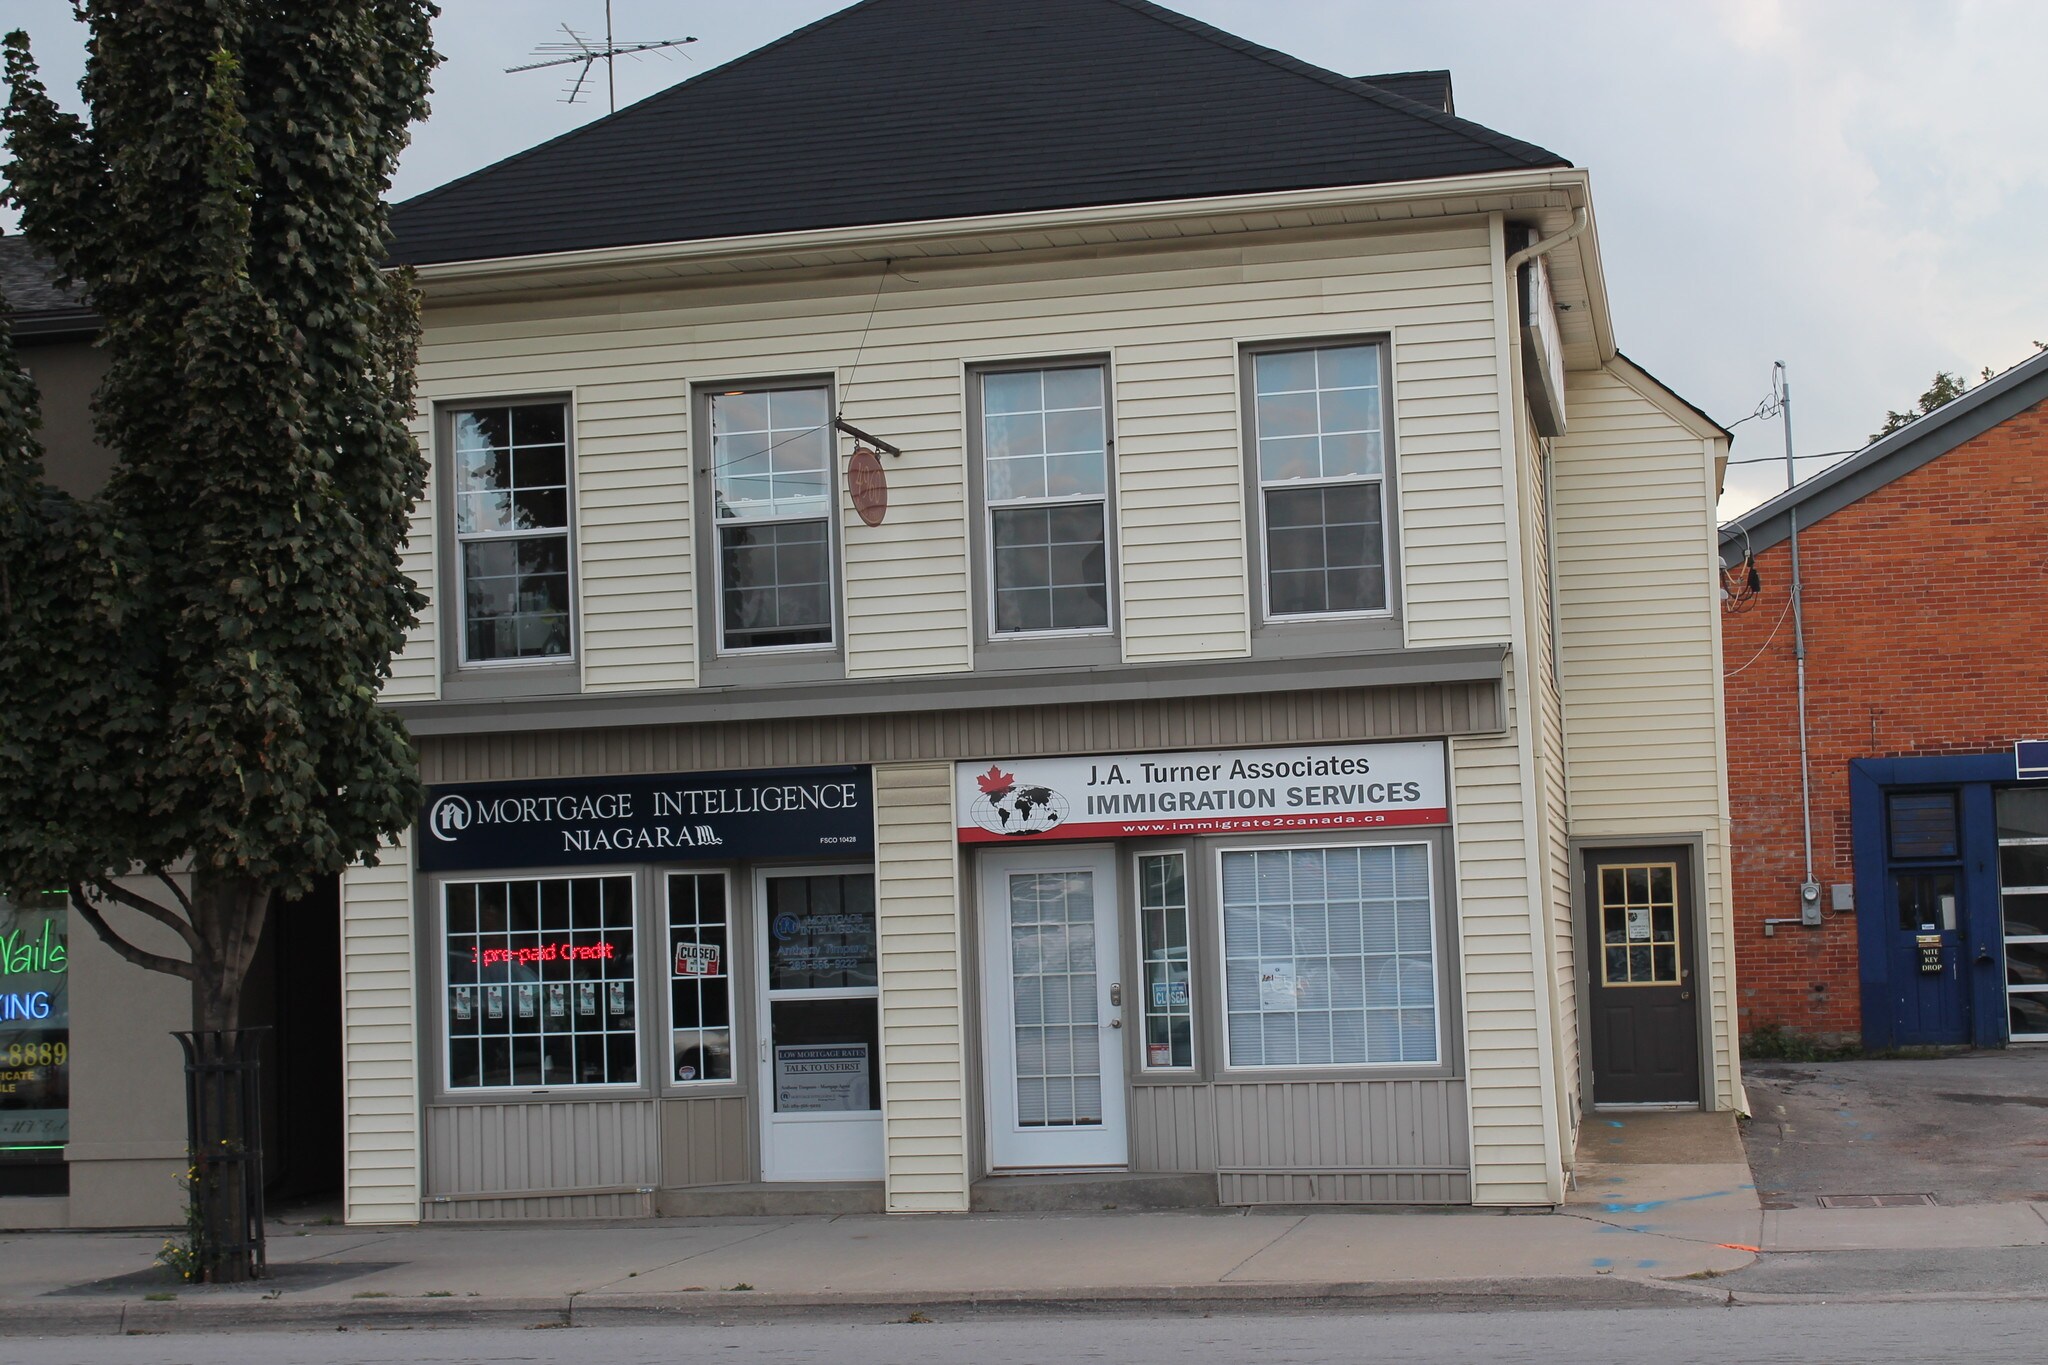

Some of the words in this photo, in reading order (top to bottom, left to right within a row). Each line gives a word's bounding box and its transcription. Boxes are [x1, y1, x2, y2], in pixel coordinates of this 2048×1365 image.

[1087, 764, 1131, 786] J.A.
[1140, 762, 1221, 784] Turner
[1229, 756, 1370, 780] Associates
[476, 794, 634, 824] MORTGAGE
[653, 783, 858, 816] INTELLIGENCE
[1087, 788, 1276, 815] IMMIGRATION
[1286, 781, 1421, 807] SERVICES
[1122, 815, 1385, 832] www.immigrate2canada.ca
[561, 825, 698, 851] NIAGARA
[483, 943, 556, 967] pre-paid
[680, 946, 716, 961] CLOSED
[0, 991, 49, 1020] ING
[779, 1051, 796, 1059] LOW
[799, 1050, 840, 1058] MORTGAGE
[842, 1048, 865, 1056] RATES
[785, 1064, 808, 1072] TALK
[809, 1063, 822, 1071] TO
[824, 1063, 835, 1071] US
[836, 1062, 860, 1070] FIRST
